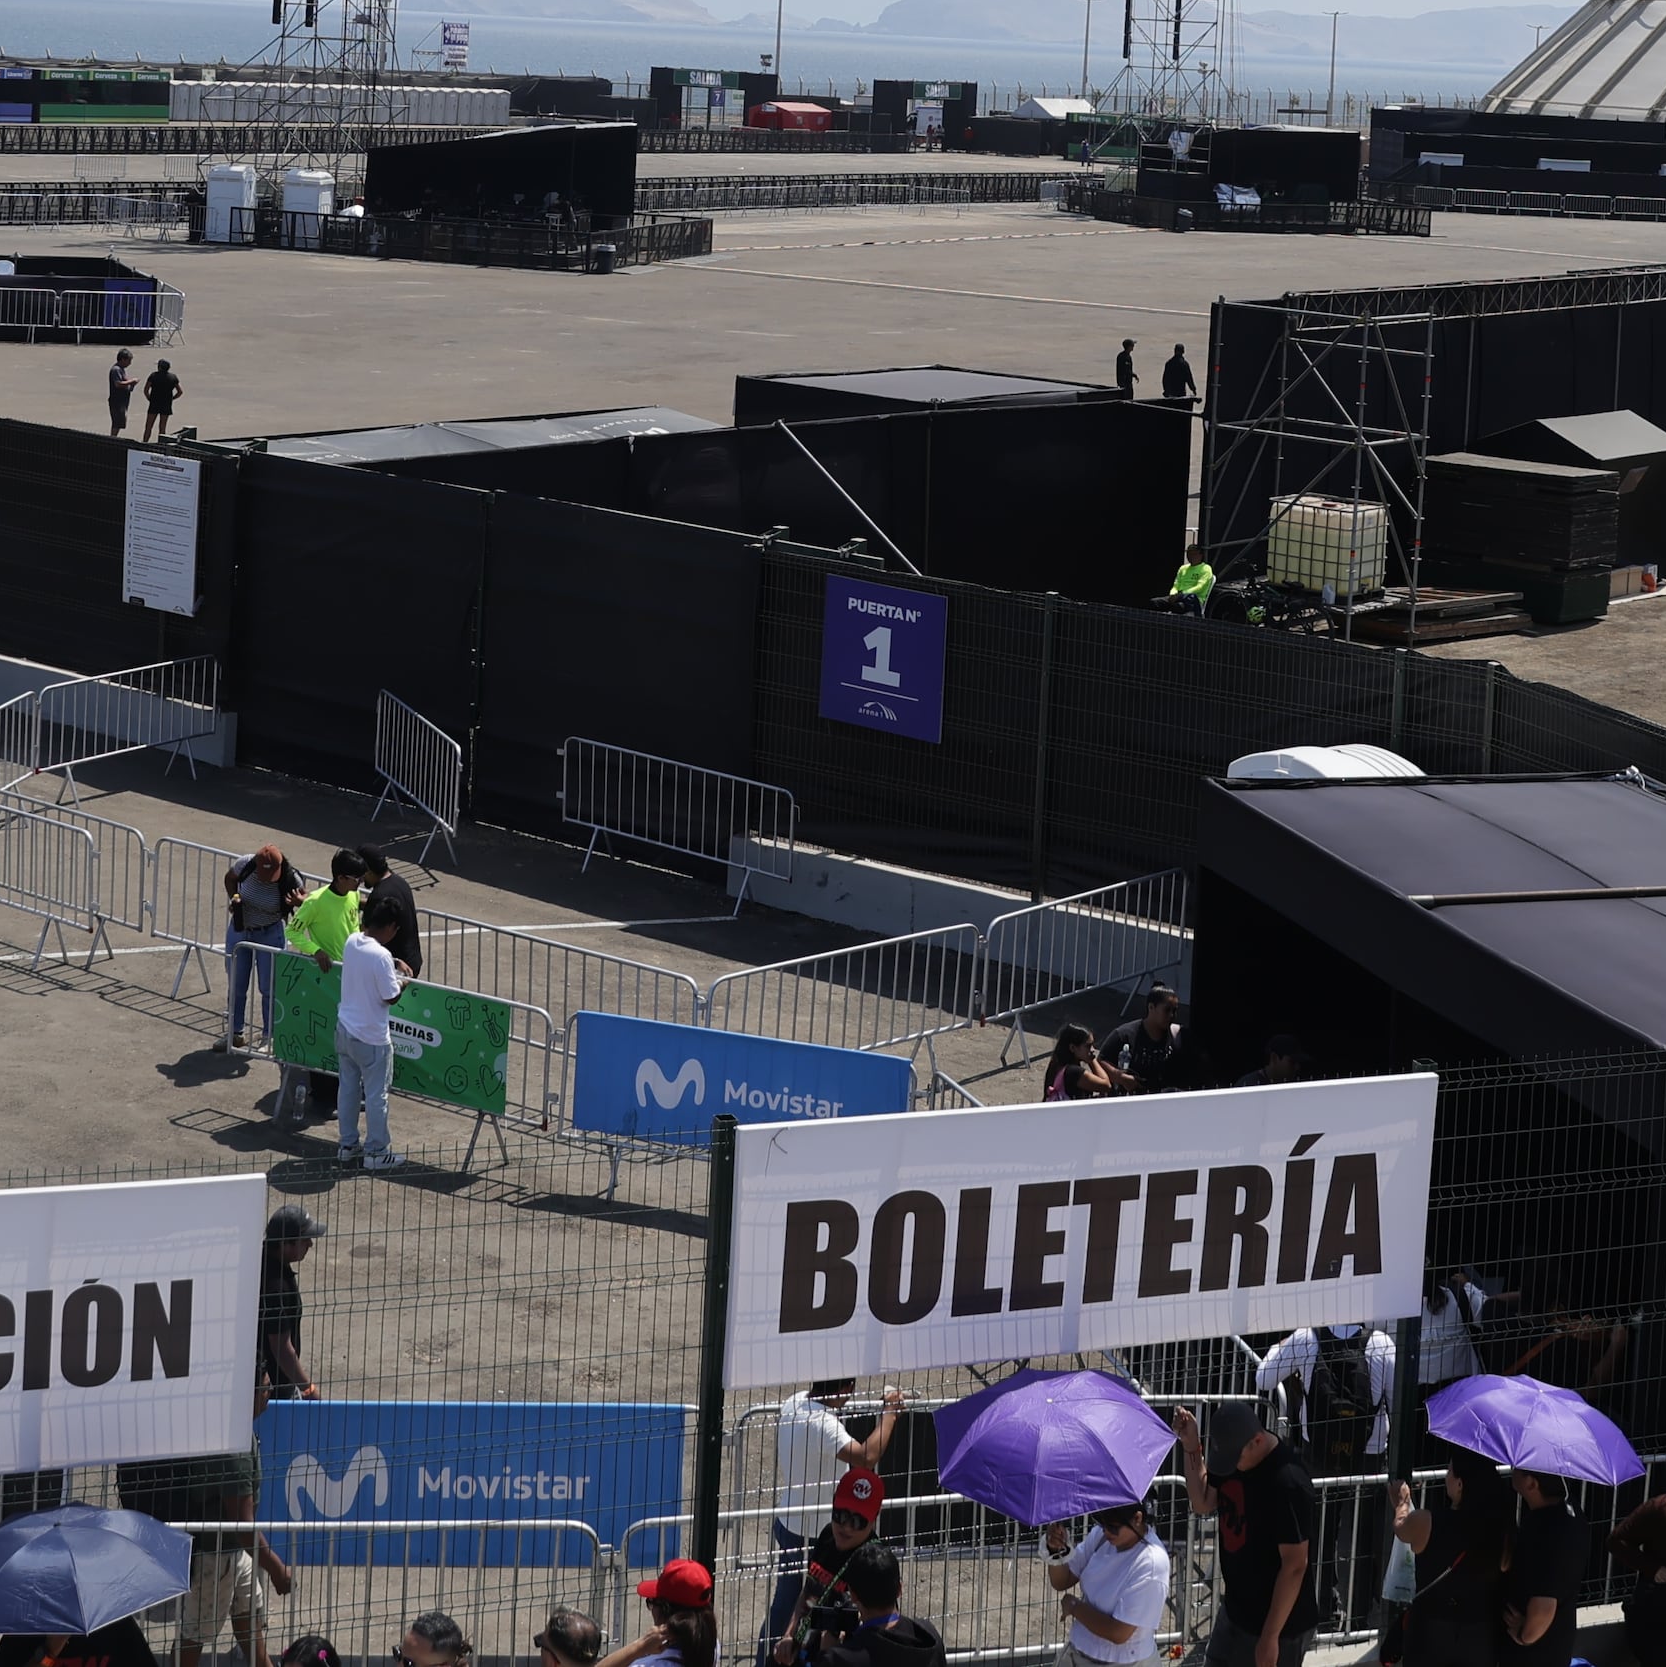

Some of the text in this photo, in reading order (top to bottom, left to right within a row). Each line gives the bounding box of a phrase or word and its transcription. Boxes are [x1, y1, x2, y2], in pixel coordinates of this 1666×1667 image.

[689, 71, 722, 85] SALIDA
[848, 597, 904, 621] PUERTA
[861, 626, 901, 688] 1
[389, 1019, 435, 1043] ENCIAS
[724, 1079, 844, 1118] Movistar
[779, 1133, 1383, 1334] BOLETERÍA
[417, 1466, 591, 1501] Movistar
